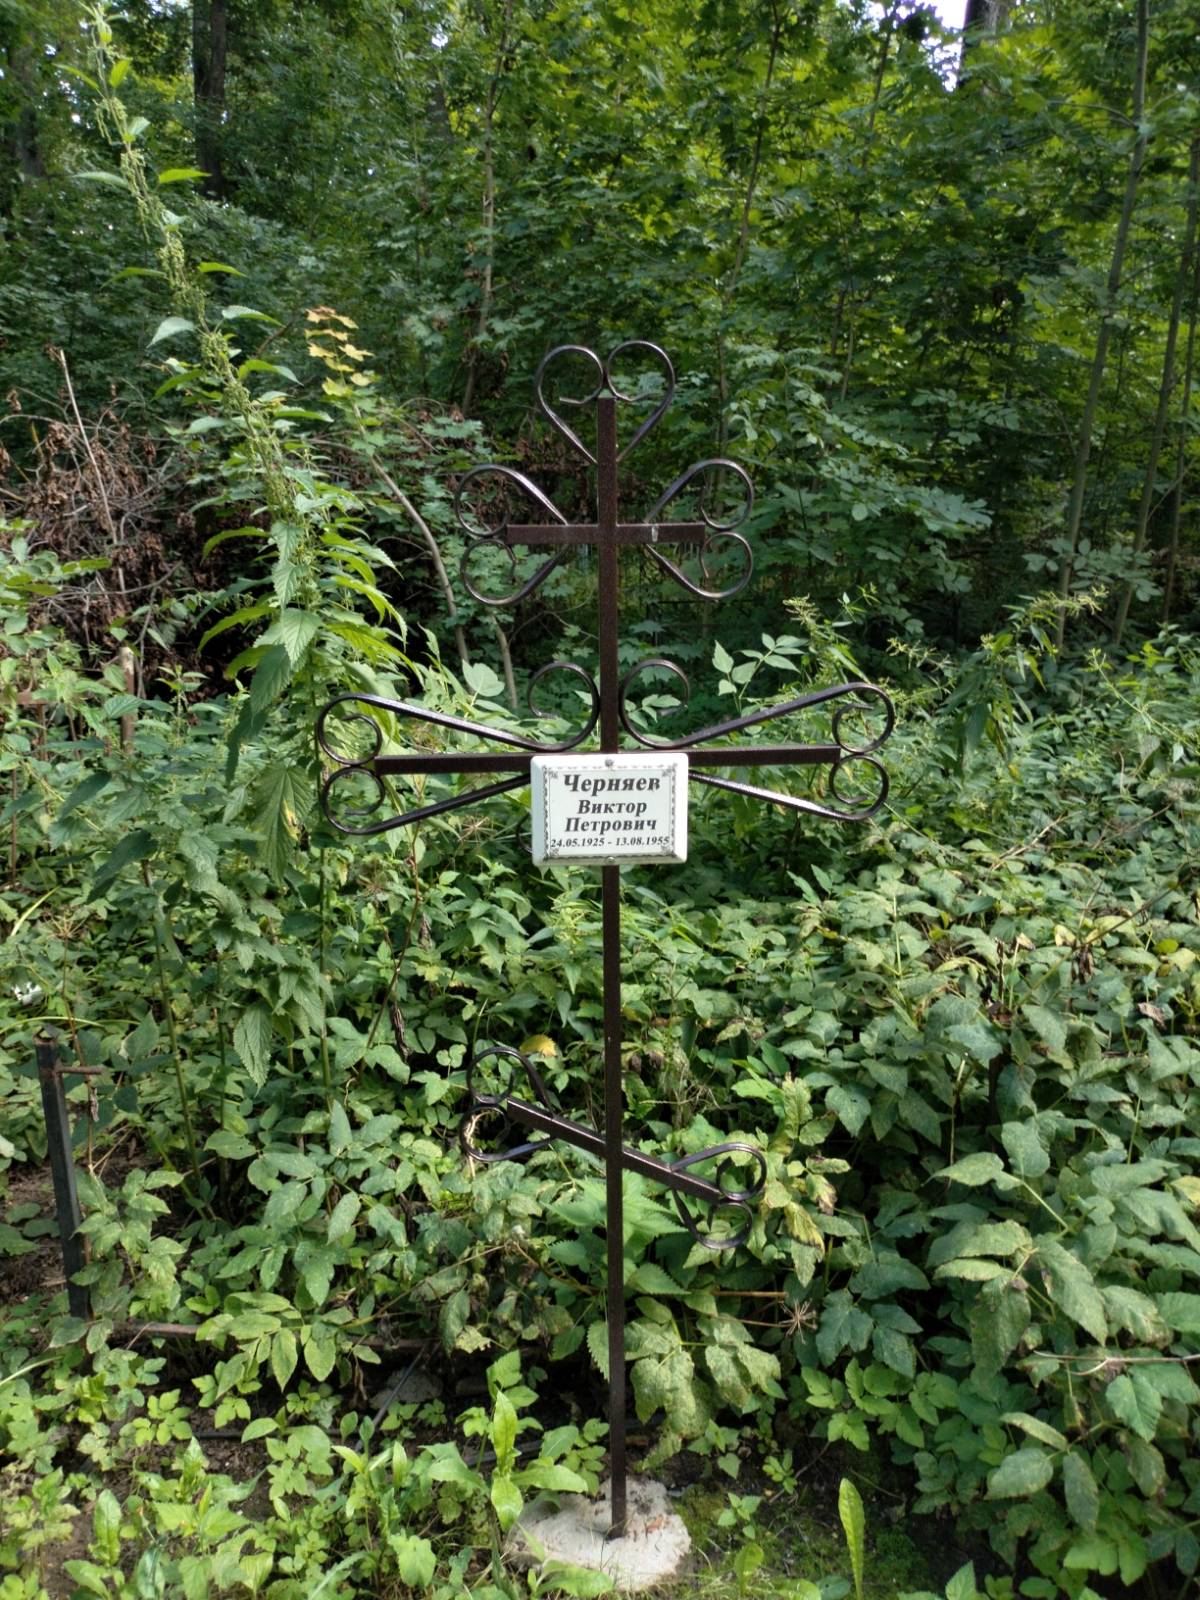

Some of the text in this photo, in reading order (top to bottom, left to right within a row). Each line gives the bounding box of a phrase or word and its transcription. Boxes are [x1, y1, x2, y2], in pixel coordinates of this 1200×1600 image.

[564, 774, 660, 796] Черняев
[577, 799, 648, 816] Виктор
[565, 817, 657, 835] Петрович
[550, 837, 605, 848] 24.05.1925
[616, 836, 670, 846] 13.08.1955
